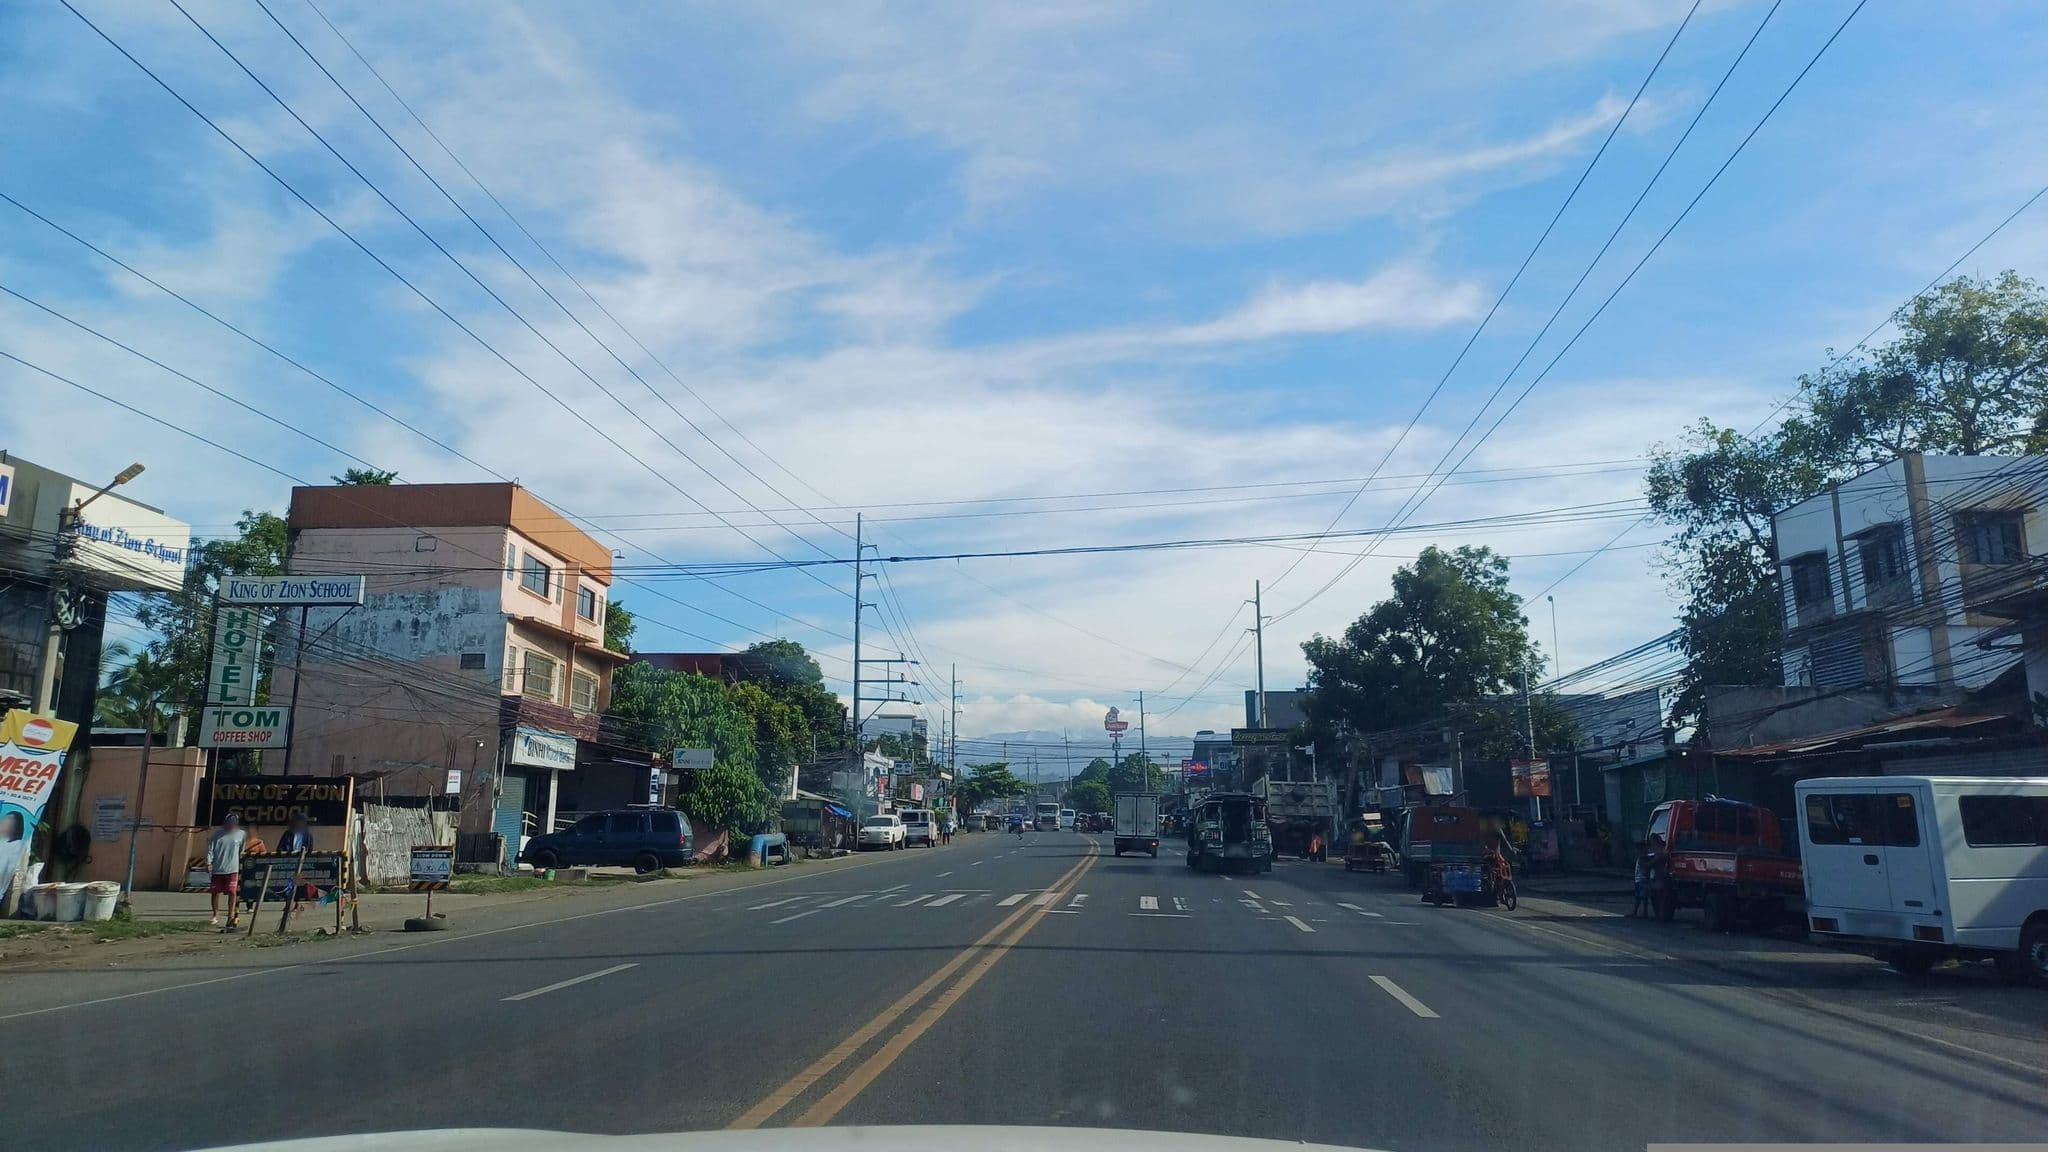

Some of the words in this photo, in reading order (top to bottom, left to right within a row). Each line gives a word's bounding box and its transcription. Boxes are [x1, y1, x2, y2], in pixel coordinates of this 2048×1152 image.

[229, 580, 258, 599] KING
[262, 583, 276, 599] OF
[279, 580, 306, 598] ZION
[309, 580, 353, 598] SCHOOL
[219, 611, 250, 702] HOTEL
[212, 710, 281, 728] TOM
[212, 730, 246, 743] COFFEE
[248, 731, 273, 743] SHOP
[0, 773, 46, 795] ALE!
[214, 783, 261, 801] KING
[264, 783, 292, 801] OF
[295, 784, 345, 801] ZION
